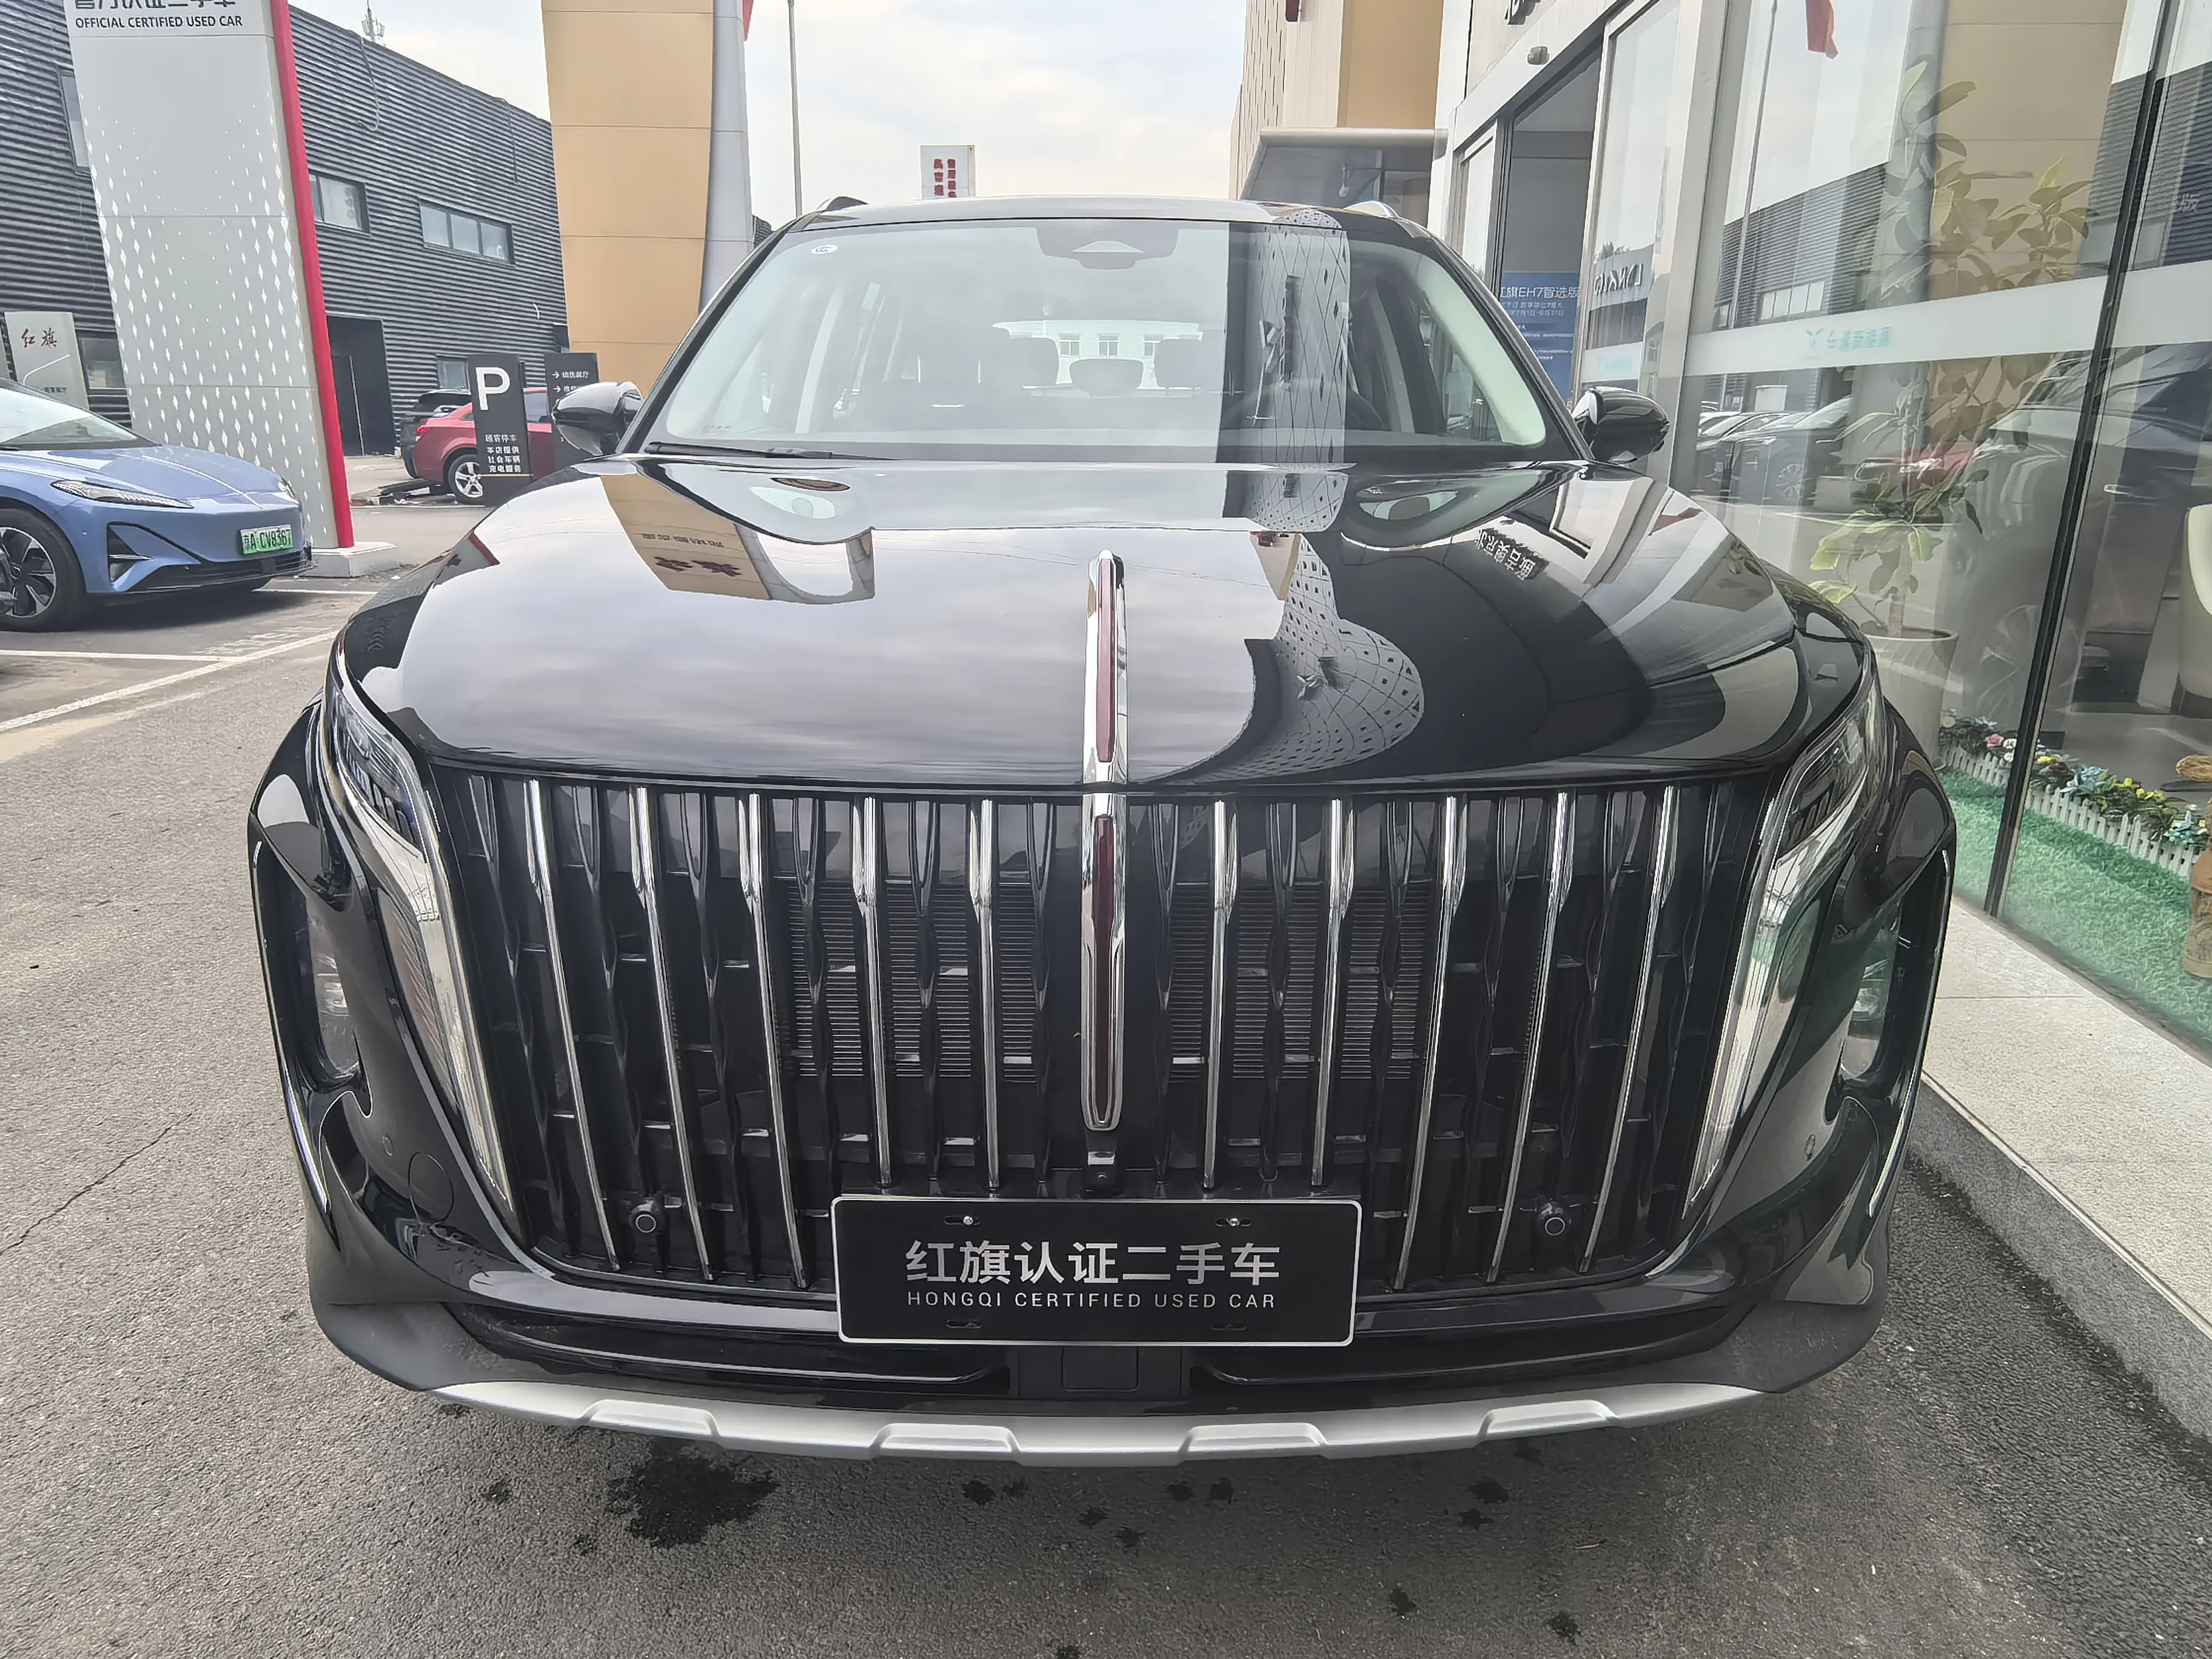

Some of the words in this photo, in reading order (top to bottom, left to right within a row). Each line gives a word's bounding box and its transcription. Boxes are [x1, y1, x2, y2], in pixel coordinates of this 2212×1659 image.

[76, 17, 126, 28] OFFICIAL
[128, 16, 183, 28] CERTIFIED
[187, 16, 216, 27] USED
[219, 15, 243, 27] CAR
[21, 327, 58, 348] 红旗
[475, 367, 511, 411] P
[486, 446, 520, 454] 本店提供
[489, 464, 521, 473] 充电服务
[905, 1240, 1280, 1285] 红旗认证二手车
[908, 1292, 1000, 1308] HONGQI
[1014, 1292, 1141, 1308] CERTIFIED
[1155, 1292, 1215, 1308] USED
[1229, 1292, 1275, 1309] CAR
